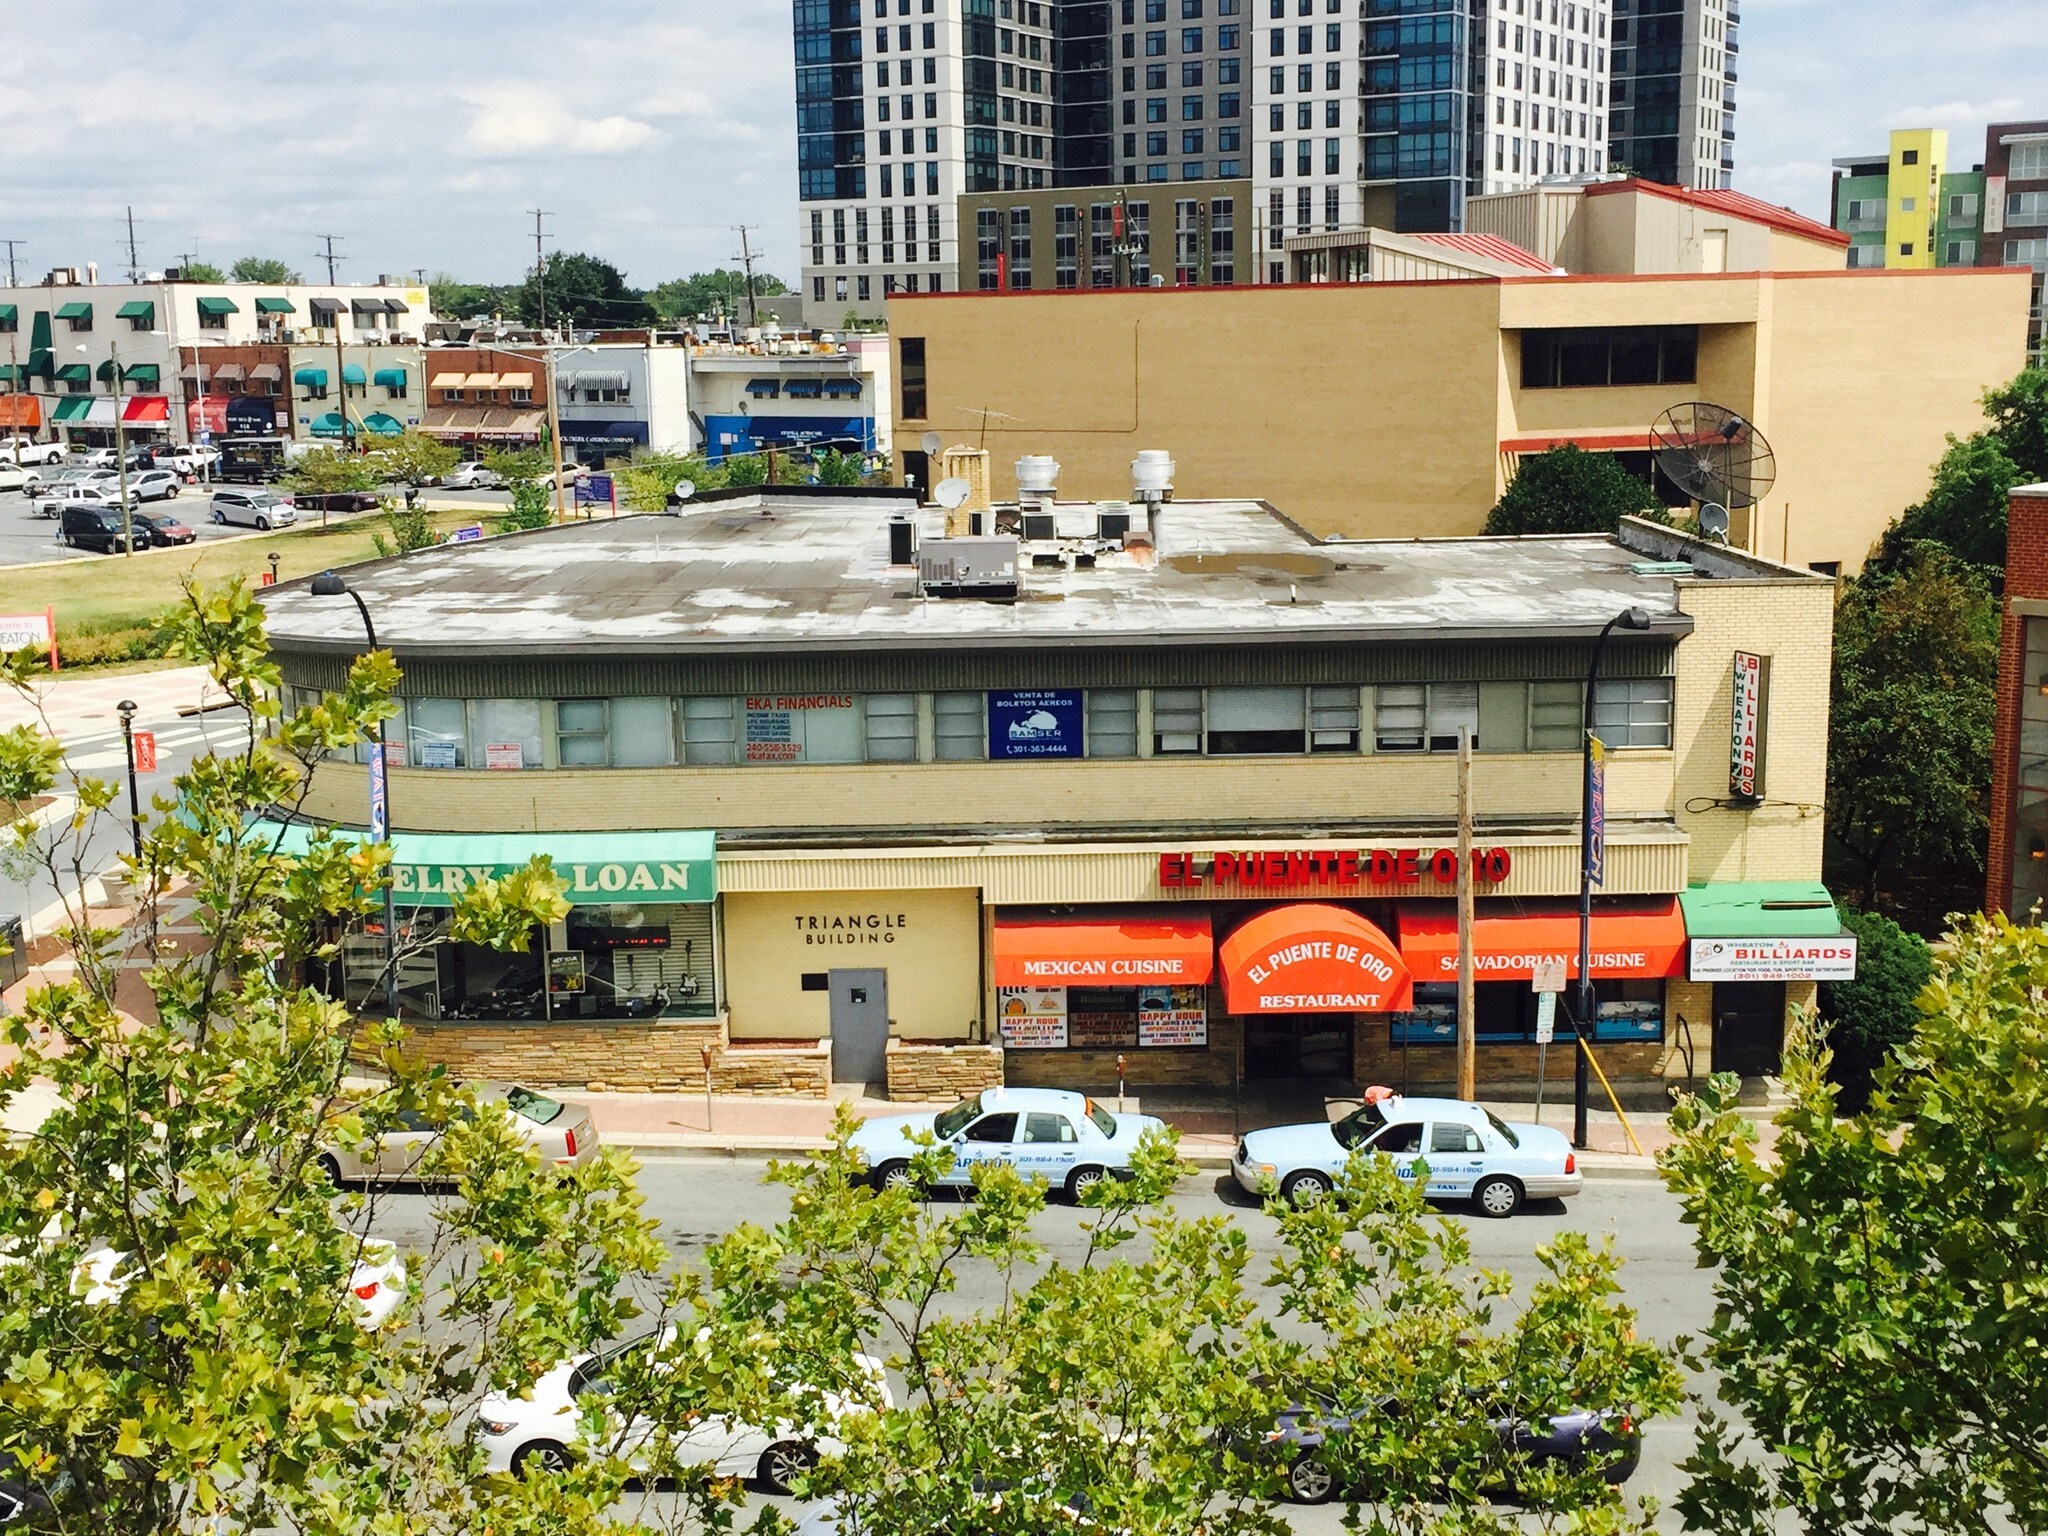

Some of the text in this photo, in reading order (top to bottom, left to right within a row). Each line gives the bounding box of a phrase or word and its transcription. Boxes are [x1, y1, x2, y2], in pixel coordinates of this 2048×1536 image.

[746, 696, 853, 710] EKA FINANCIALS
[1732, 672, 1746, 760] WHEATON
[1010, 730, 1062, 738] SAMSER
[1741, 657, 1759, 795] BILLIARDS
[1013, 745, 1068, 754] 301-363-4444
[1591, 761, 1604, 878] WHEATON
[1159, 852, 1202, 887] EL
[1213, 850, 1359, 887] PUENTE
[1370, 849, 1420, 884] DE
[572, 863, 690, 892] LOAN
[795, 914, 906, 930] TRIANGLE
[806, 932, 895, 944] BUILDING
[1440, 954, 1567, 970] SAVADORIAN
[1735, 949, 1853, 960] BILLIARDS
[1024, 959, 1183, 975] MEXICAN CUISINE
[1247, 942, 1394, 985] EL PUENTE DE ORO
[1259, 994, 1380, 1008] RESTAURANT
[1140, 1011, 1202, 1021] HAPPY HOUR
